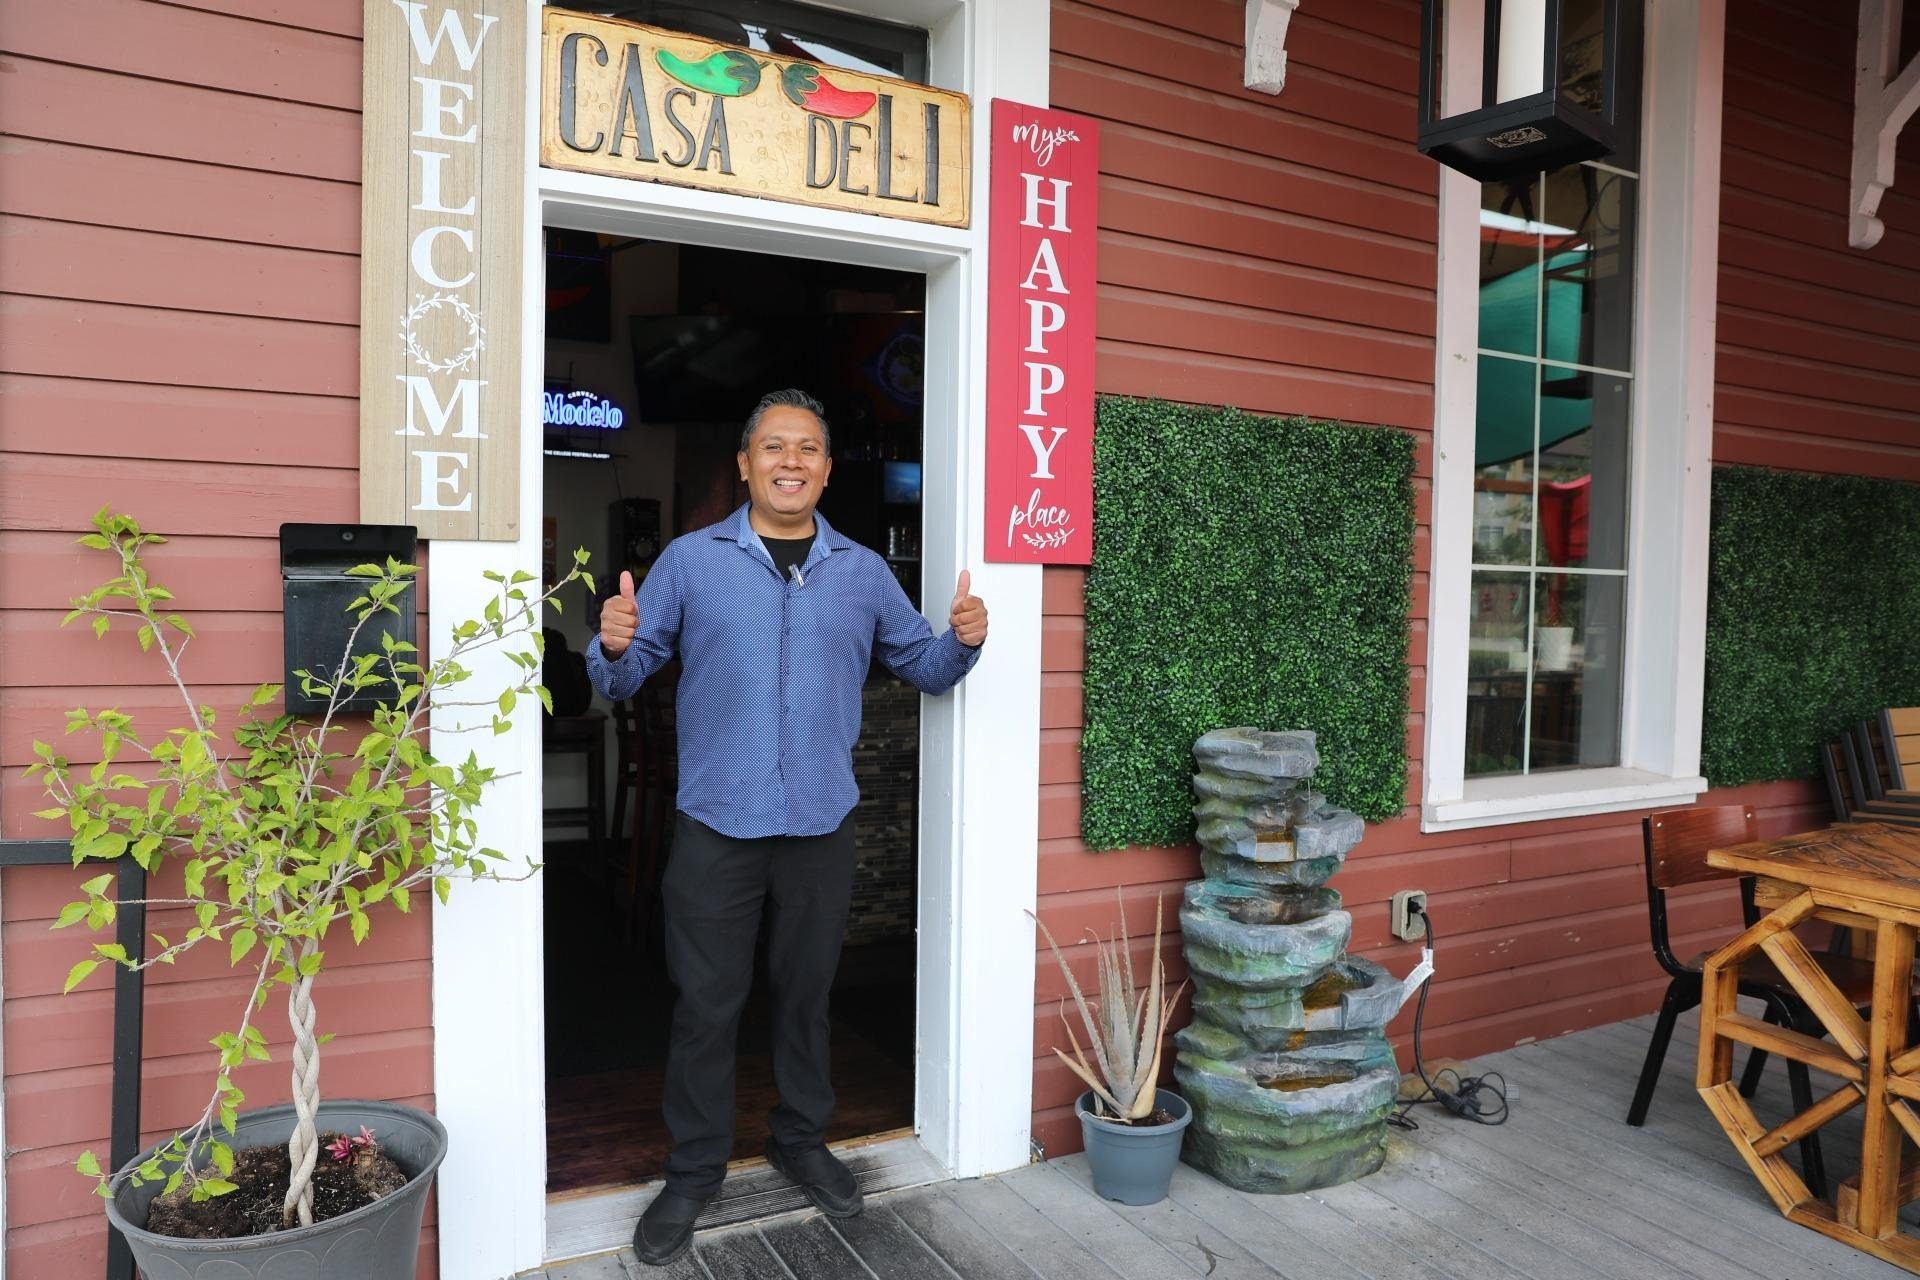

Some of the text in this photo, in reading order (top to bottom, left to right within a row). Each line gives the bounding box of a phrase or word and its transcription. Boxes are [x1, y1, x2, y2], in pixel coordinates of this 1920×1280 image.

[559, 32, 941, 207] CASA DELI
[1013, 123, 1055, 167] my
[393, 0, 499, 513] WELCOME
[1018, 172, 1073, 480] HAPPY
[543, 392, 623, 429] Modelo
[567, 390, 598, 401] CERVEZA
[1007, 487, 1071, 548] place
